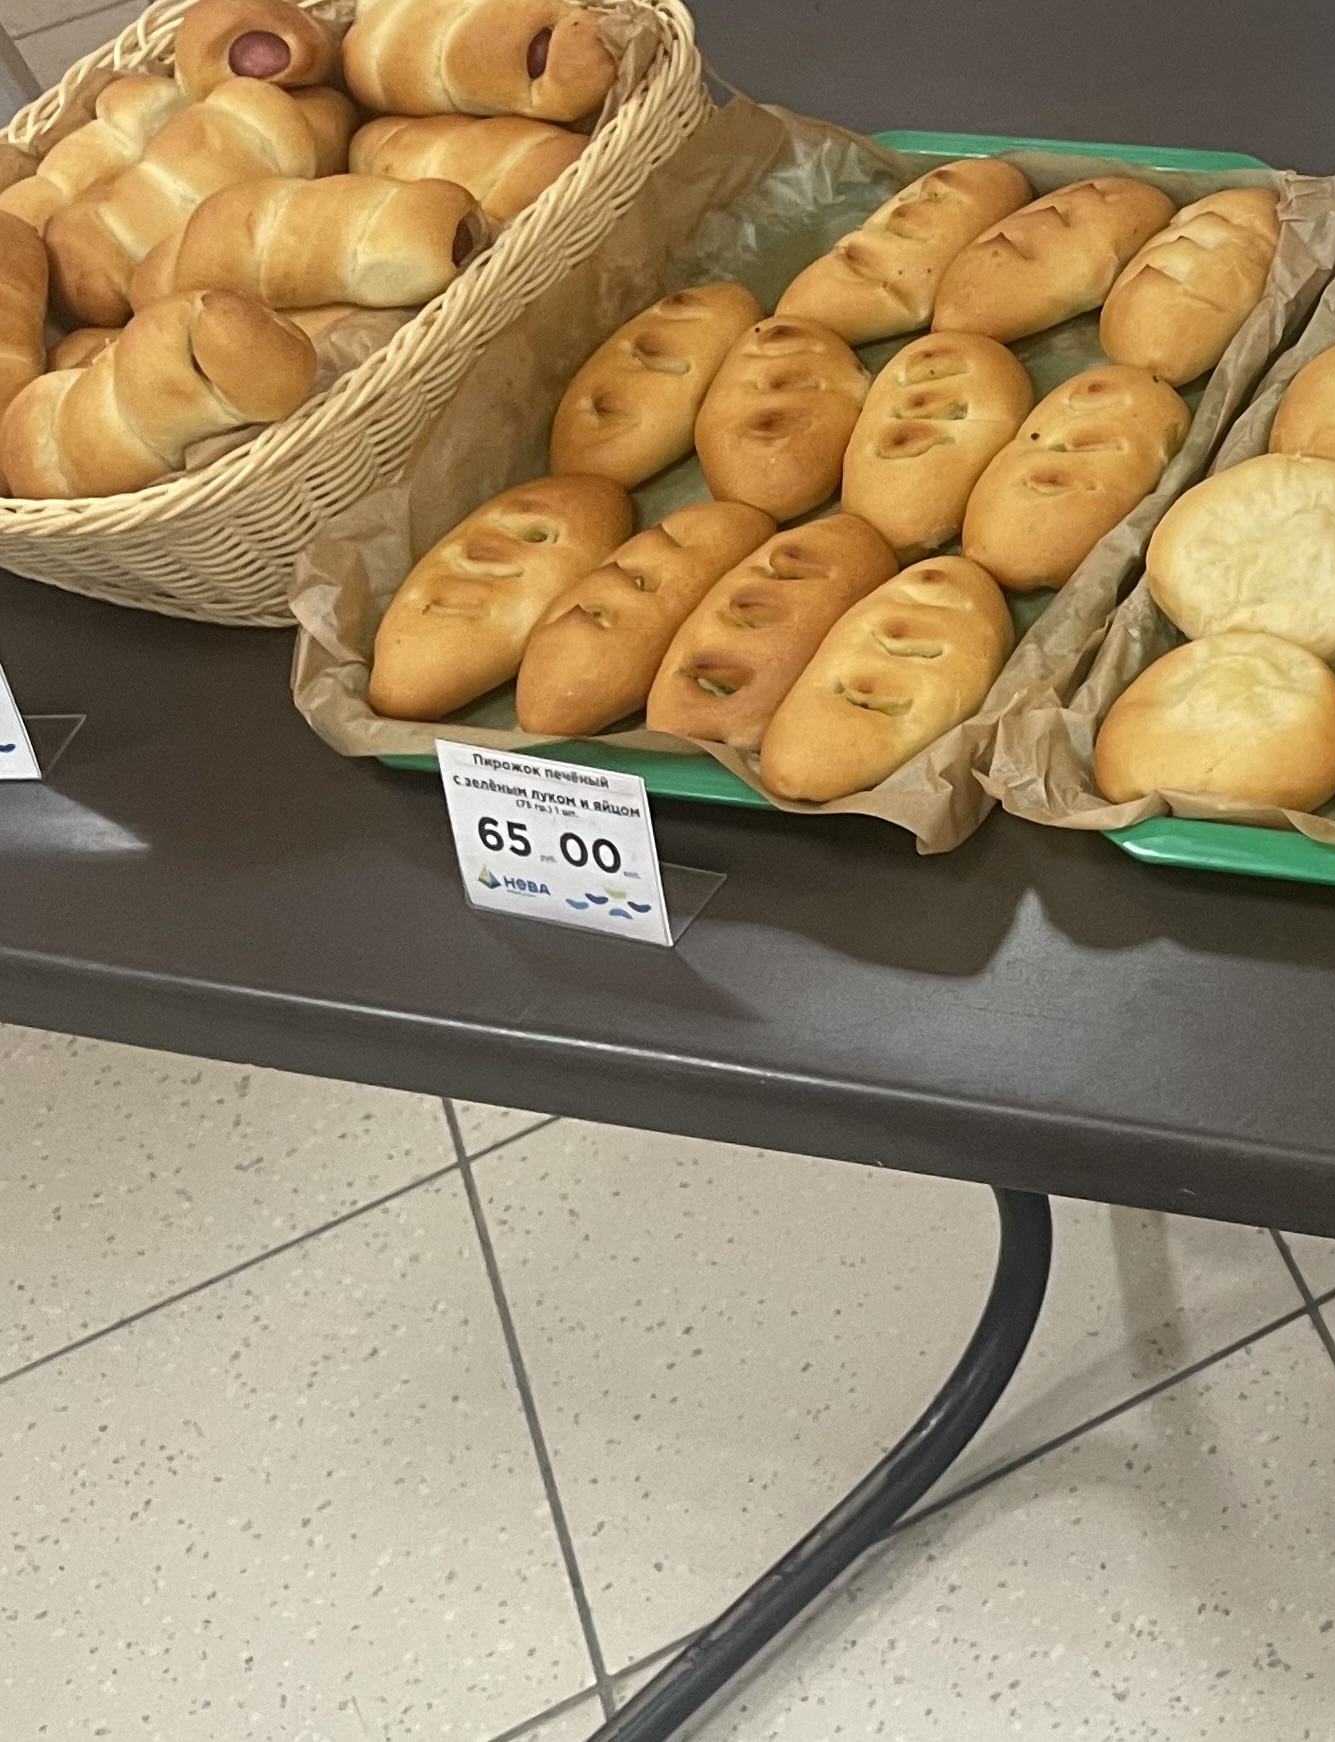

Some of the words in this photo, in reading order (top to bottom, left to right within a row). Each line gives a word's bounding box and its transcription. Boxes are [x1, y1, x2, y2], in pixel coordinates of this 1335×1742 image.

[473, 753, 541, 778] Пирожок
[545, 768, 609, 789] печёный
[453, 774, 462, 785] с
[465, 777, 528, 798] зелёным
[531, 789, 576, 807] луком
[580, 799, 590, 809] и
[593, 800, 641, 818] яйцом
[478, 816, 532, 857] 65
[560, 832, 621, 873] 00
